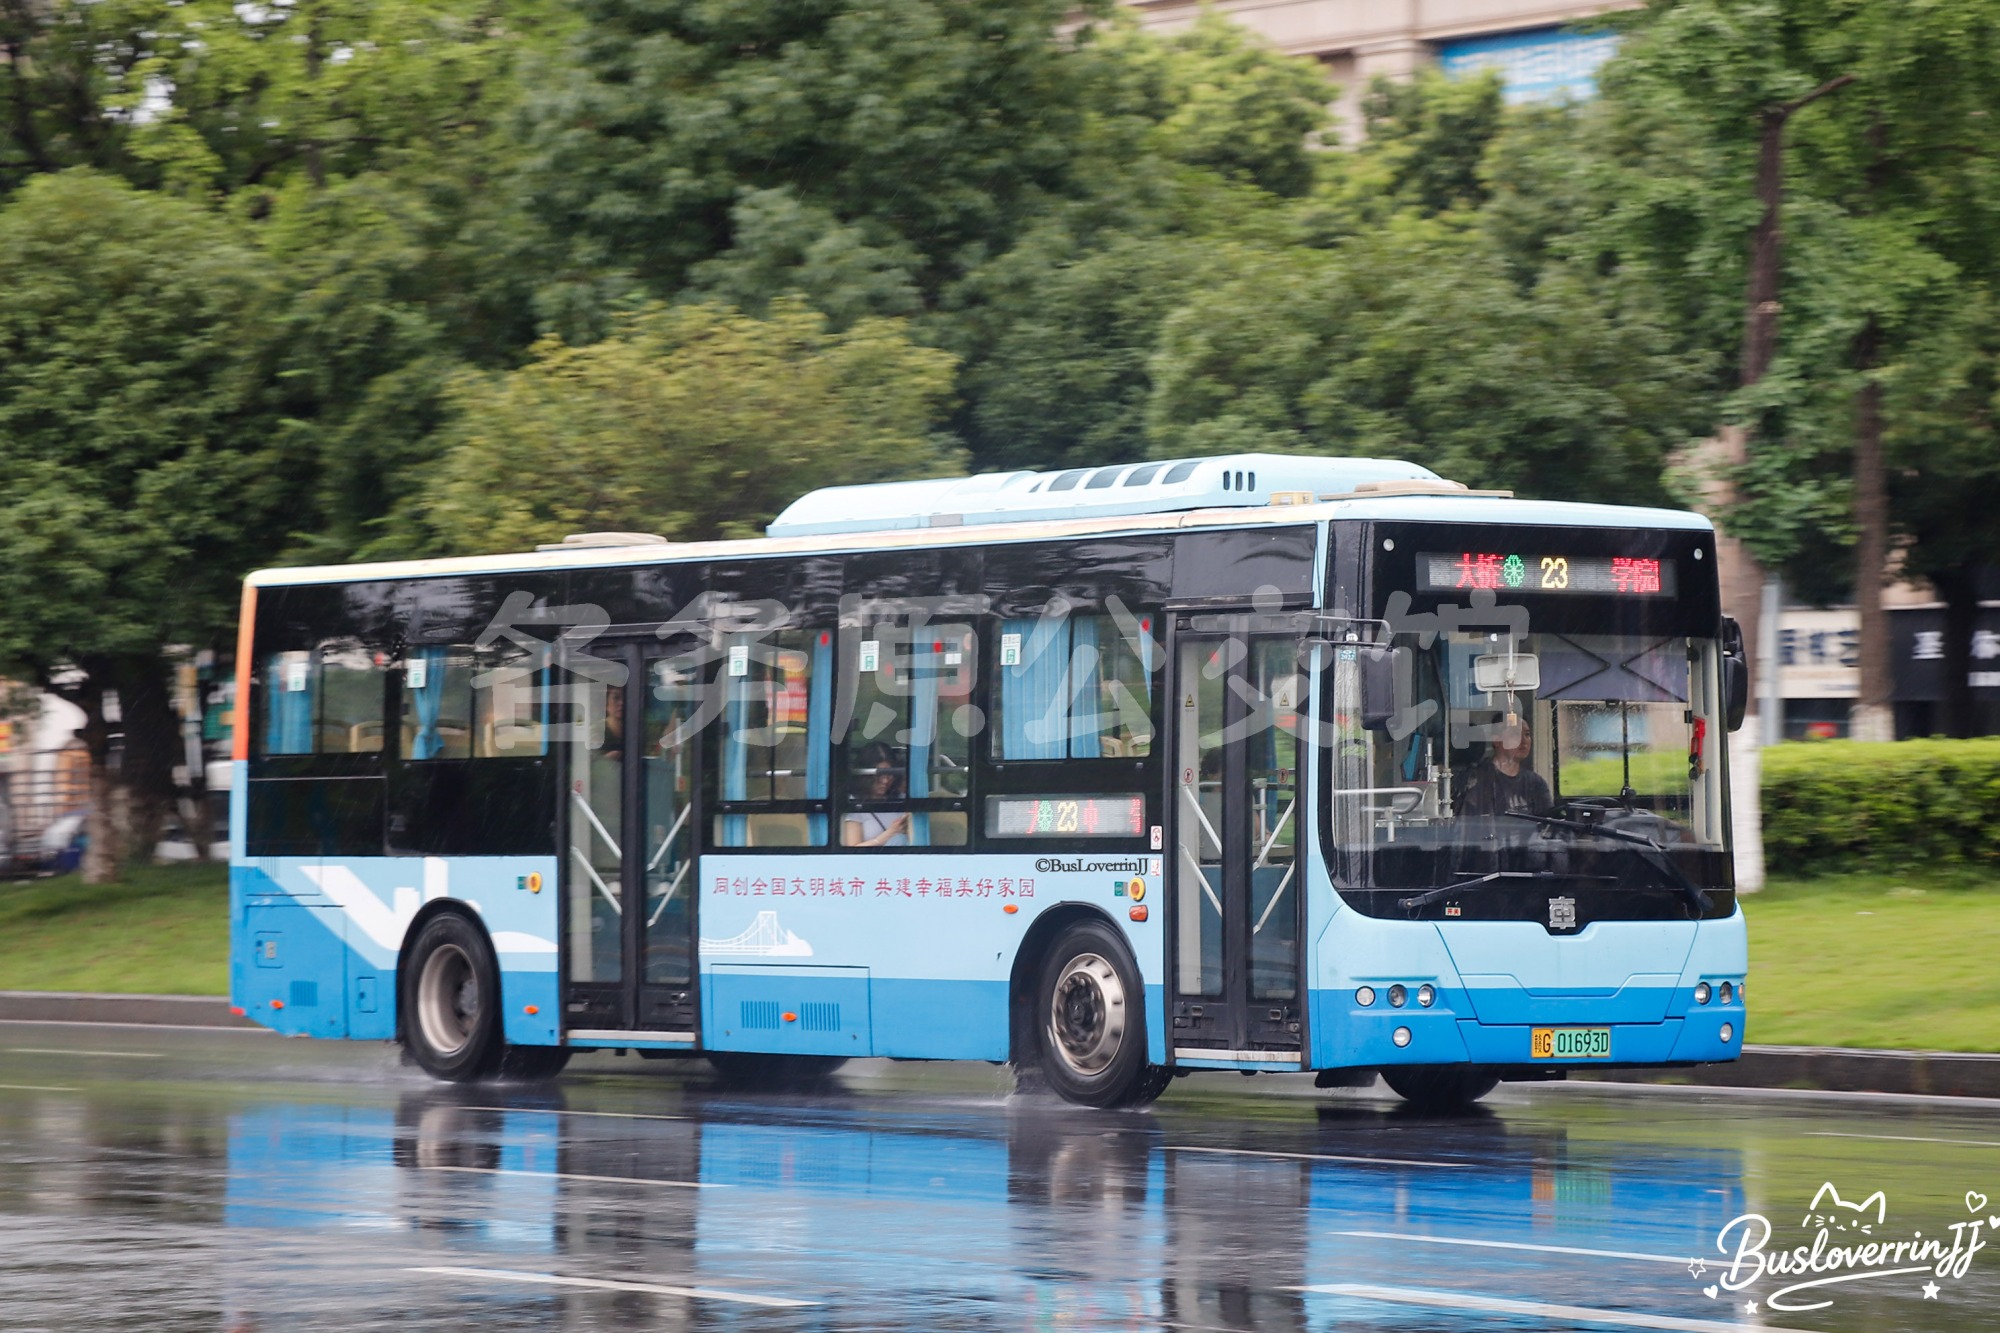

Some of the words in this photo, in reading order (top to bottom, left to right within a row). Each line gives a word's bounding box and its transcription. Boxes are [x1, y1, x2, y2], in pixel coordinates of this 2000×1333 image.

[1540, 557, 1568, 589] 23
[1057, 801, 1078, 832] 23
[713, 876, 866, 897] 同创全国文明城市
[875, 877, 1035, 898] 共建幸福美好家园
[1557, 1032, 1609, 1053] 01693D
